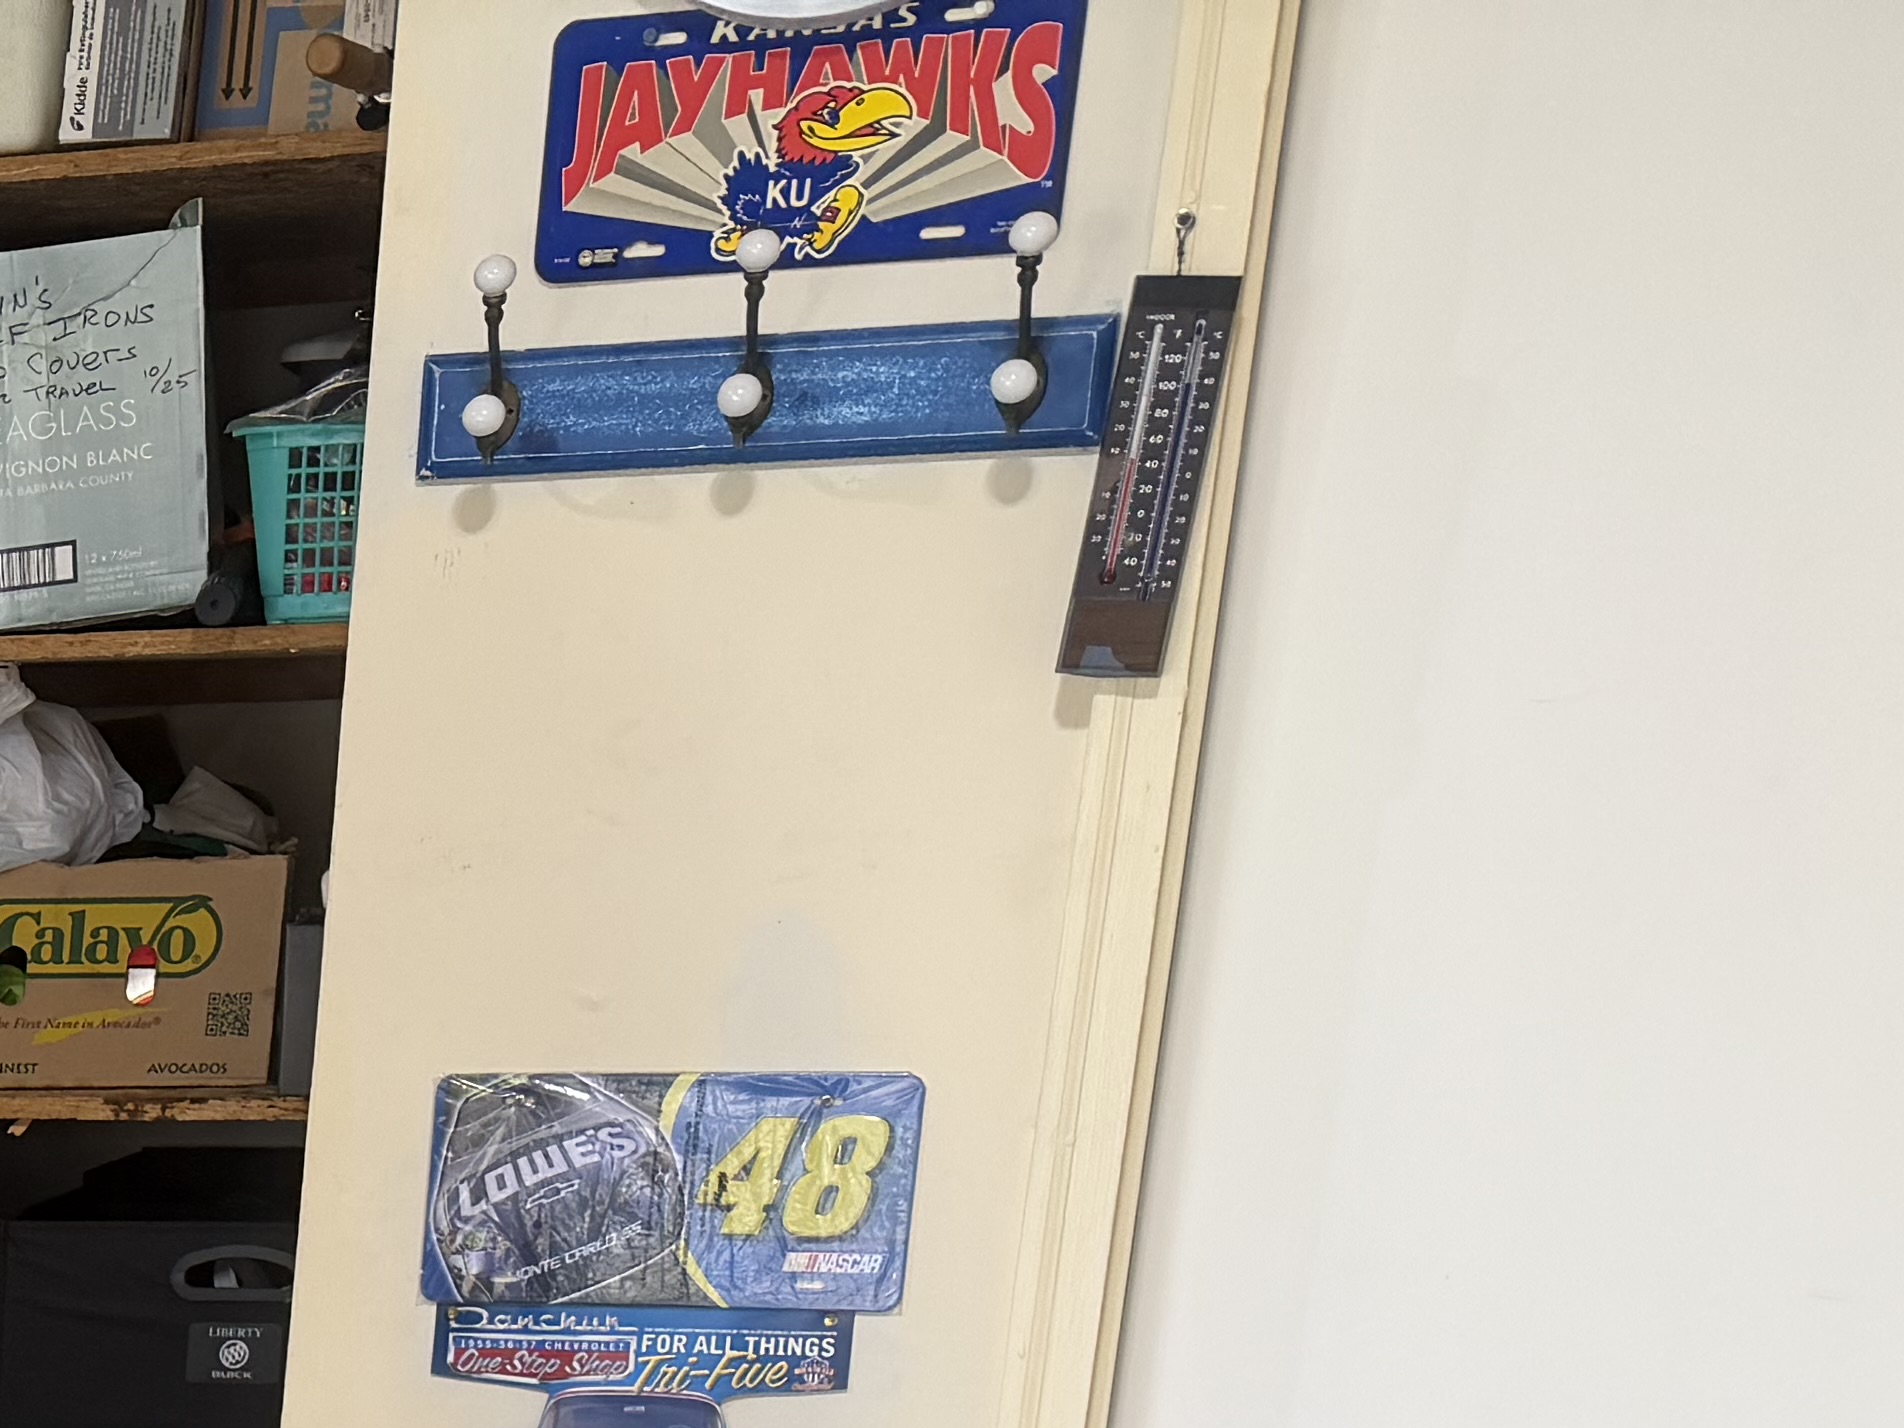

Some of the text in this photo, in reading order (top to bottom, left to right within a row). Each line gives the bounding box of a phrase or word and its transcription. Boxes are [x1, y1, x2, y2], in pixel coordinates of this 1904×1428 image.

[73, 77, 88, 115] Kidde
[562, 22, 1064, 211] JAYHAWKS
[766, 176, 812, 209] KU
[46, 304, 155, 342] IRONS
[1149, 434, 1164, 444] 60
[86, 443, 153, 468] BLANC
[1145, 459, 1159, 468] 40
[79, 470, 135, 488] COUNTY
[1138, 484, 1153, 493] 20
[1137, 509, 1145, 518] 0
[1123, 557, 1138, 566] 40
[12, 1017, 41, 1030] First
[43, 1017, 78, 1030] Name
[80, 1018, 94, 1030] in
[96, 1016, 152, 1030] Avocados
[146, 1062, 228, 1076] AVOCADOS
[458, 1125, 638, 1217] LOWE'S
[695, 1114, 891, 1239] 48
[565, 1232, 617, 1264] CARLO
[815, 1255, 883, 1274] NASCAR
[208, 1326, 264, 1338] LIBERTY
[544, 1341, 625, 1351] CHEVROLET
[641, 1334, 836, 1358] FOR ALL THINGS
[457, 1349, 628, 1377] One-Stop Shop
[633, 1350, 790, 1395] Tri-Five
